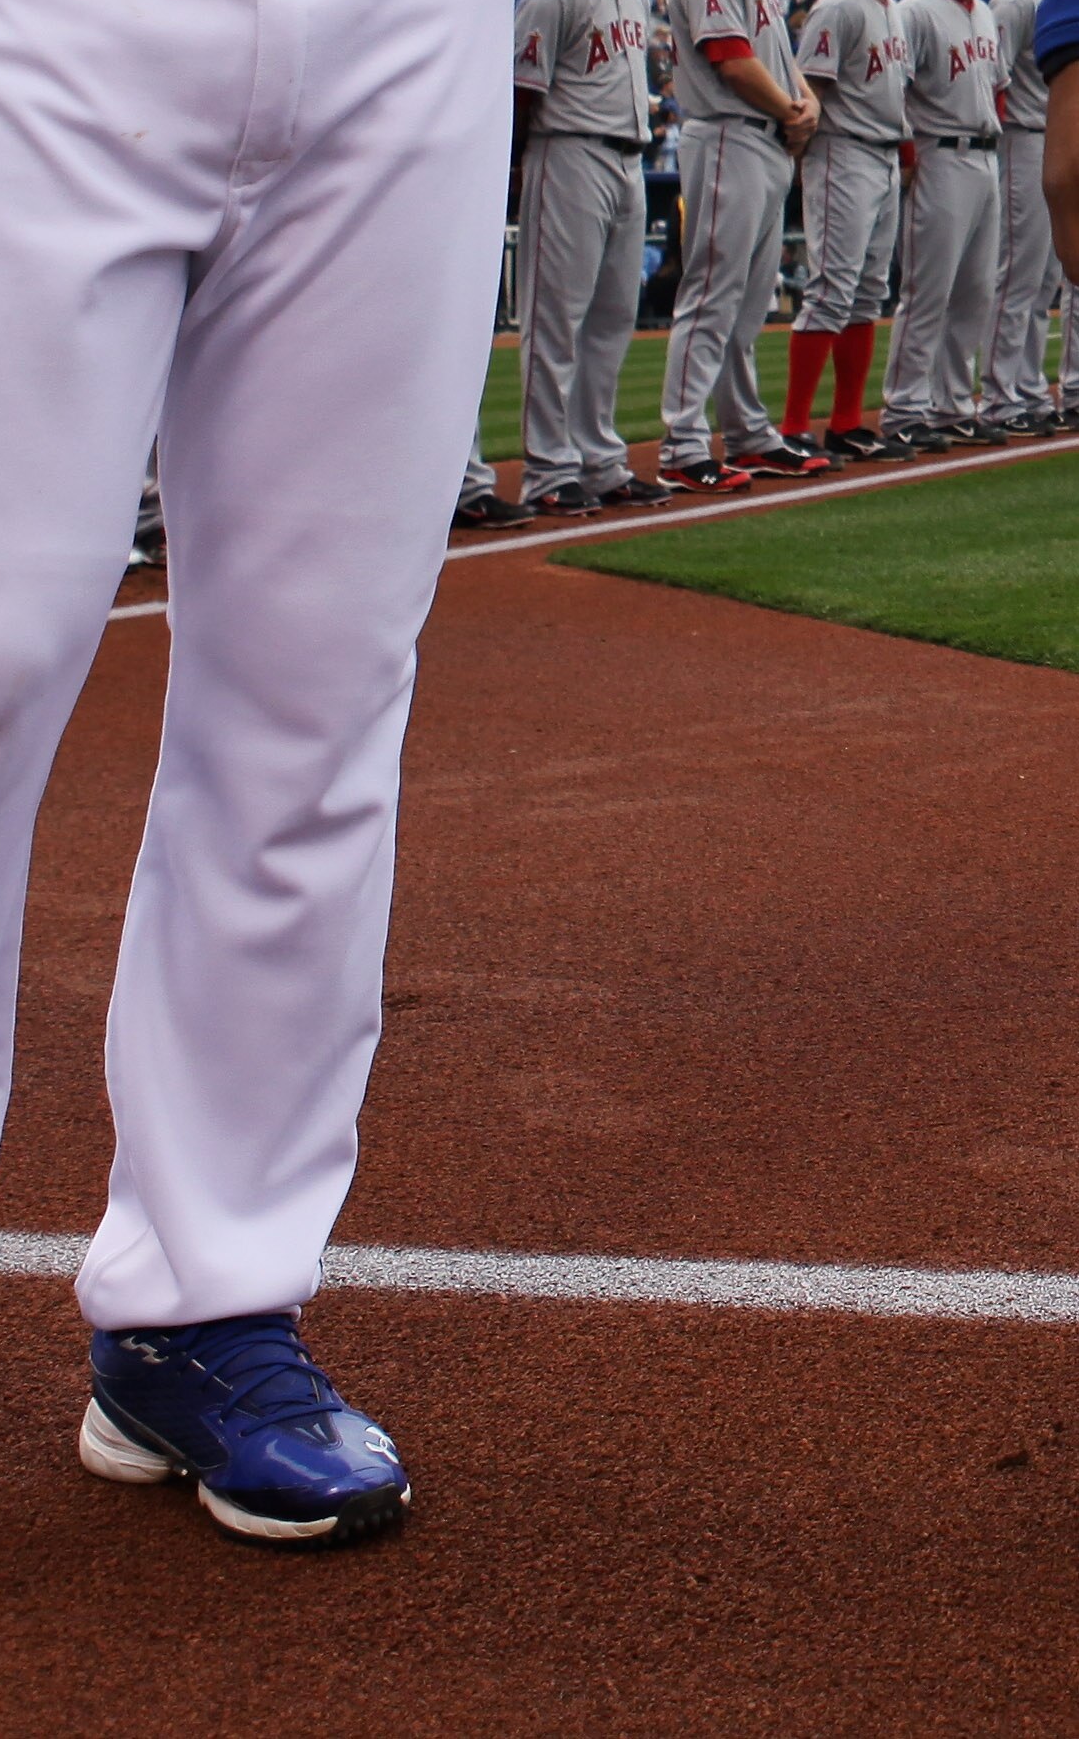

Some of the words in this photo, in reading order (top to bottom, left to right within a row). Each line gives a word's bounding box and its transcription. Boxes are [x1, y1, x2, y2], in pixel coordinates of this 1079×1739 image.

[520, 29, 541, 67] A
[585, 19, 646, 76] ANGE
[815, 29, 831, 58] A
[864, 36, 907, 82] ANGE
[947, 35, 997, 82] ANGE
